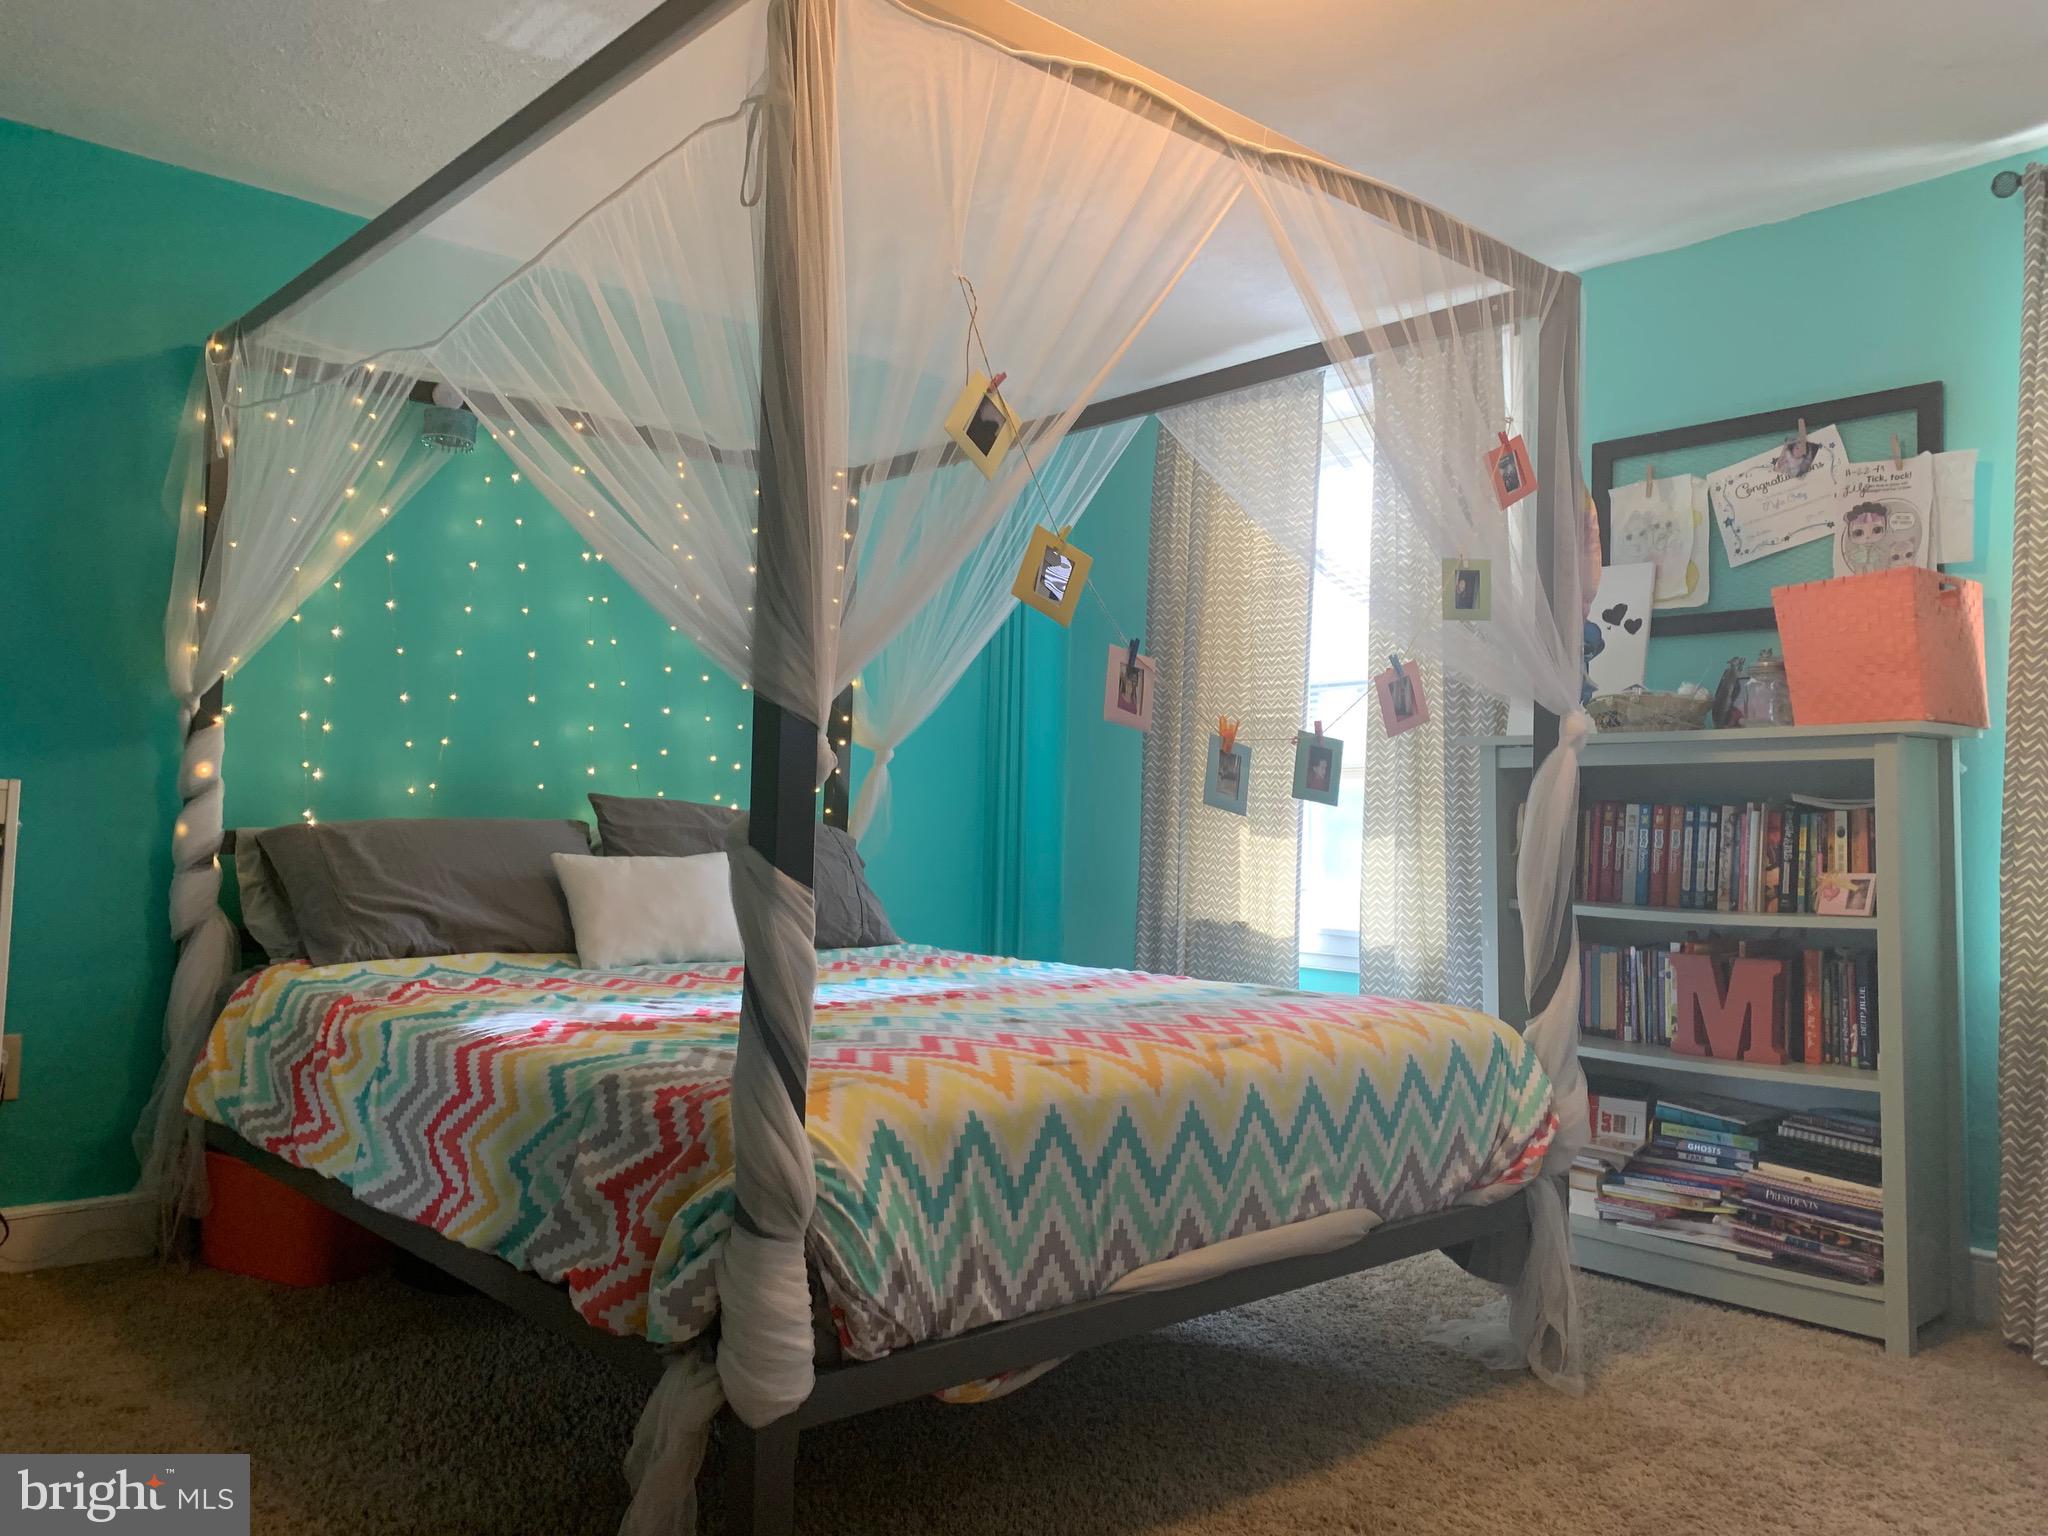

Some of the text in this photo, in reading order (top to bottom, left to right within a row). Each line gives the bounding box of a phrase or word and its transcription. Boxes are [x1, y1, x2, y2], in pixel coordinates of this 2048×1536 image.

[1735, 461, 1824, 499] Congratuons
[1671, 951, 1784, 1065] M
[1687, 1142, 1722, 1155] GHOSTS
[1765, 1189, 1819, 1210] PRESIDENTS
